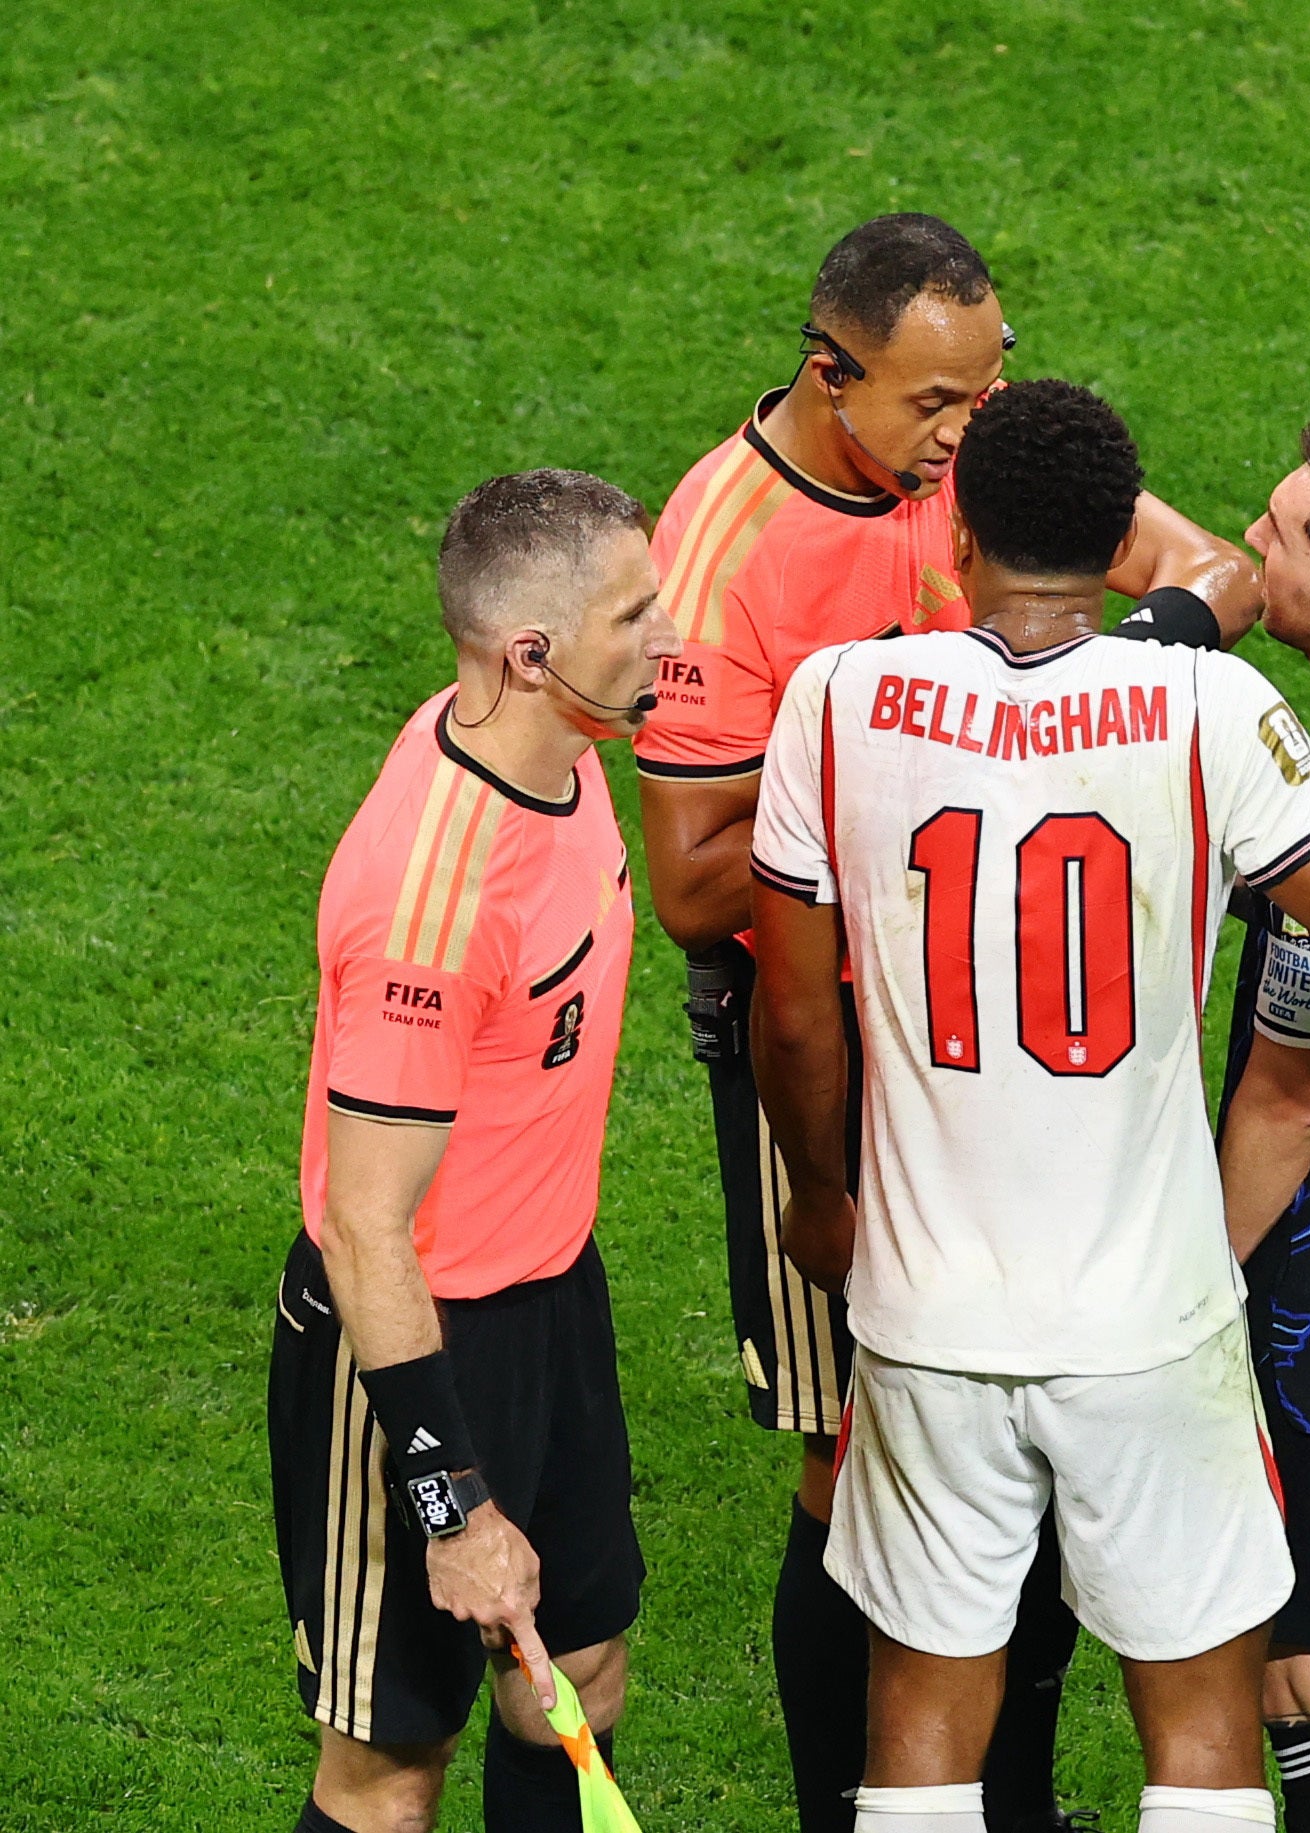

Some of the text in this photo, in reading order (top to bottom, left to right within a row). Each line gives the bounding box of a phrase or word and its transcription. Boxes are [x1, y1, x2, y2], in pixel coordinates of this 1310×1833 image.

[661, 660, 705, 687] IFA
[656, 690, 707, 706] AM ONE
[868, 675, 1169, 761] BELLINGHAM
[908, 805, 1138, 1078] 10
[385, 981, 443, 1012] FIFA
[382, 1010, 442, 1030] TEAM ONE
[417, 1479, 450, 1526] 48:43
